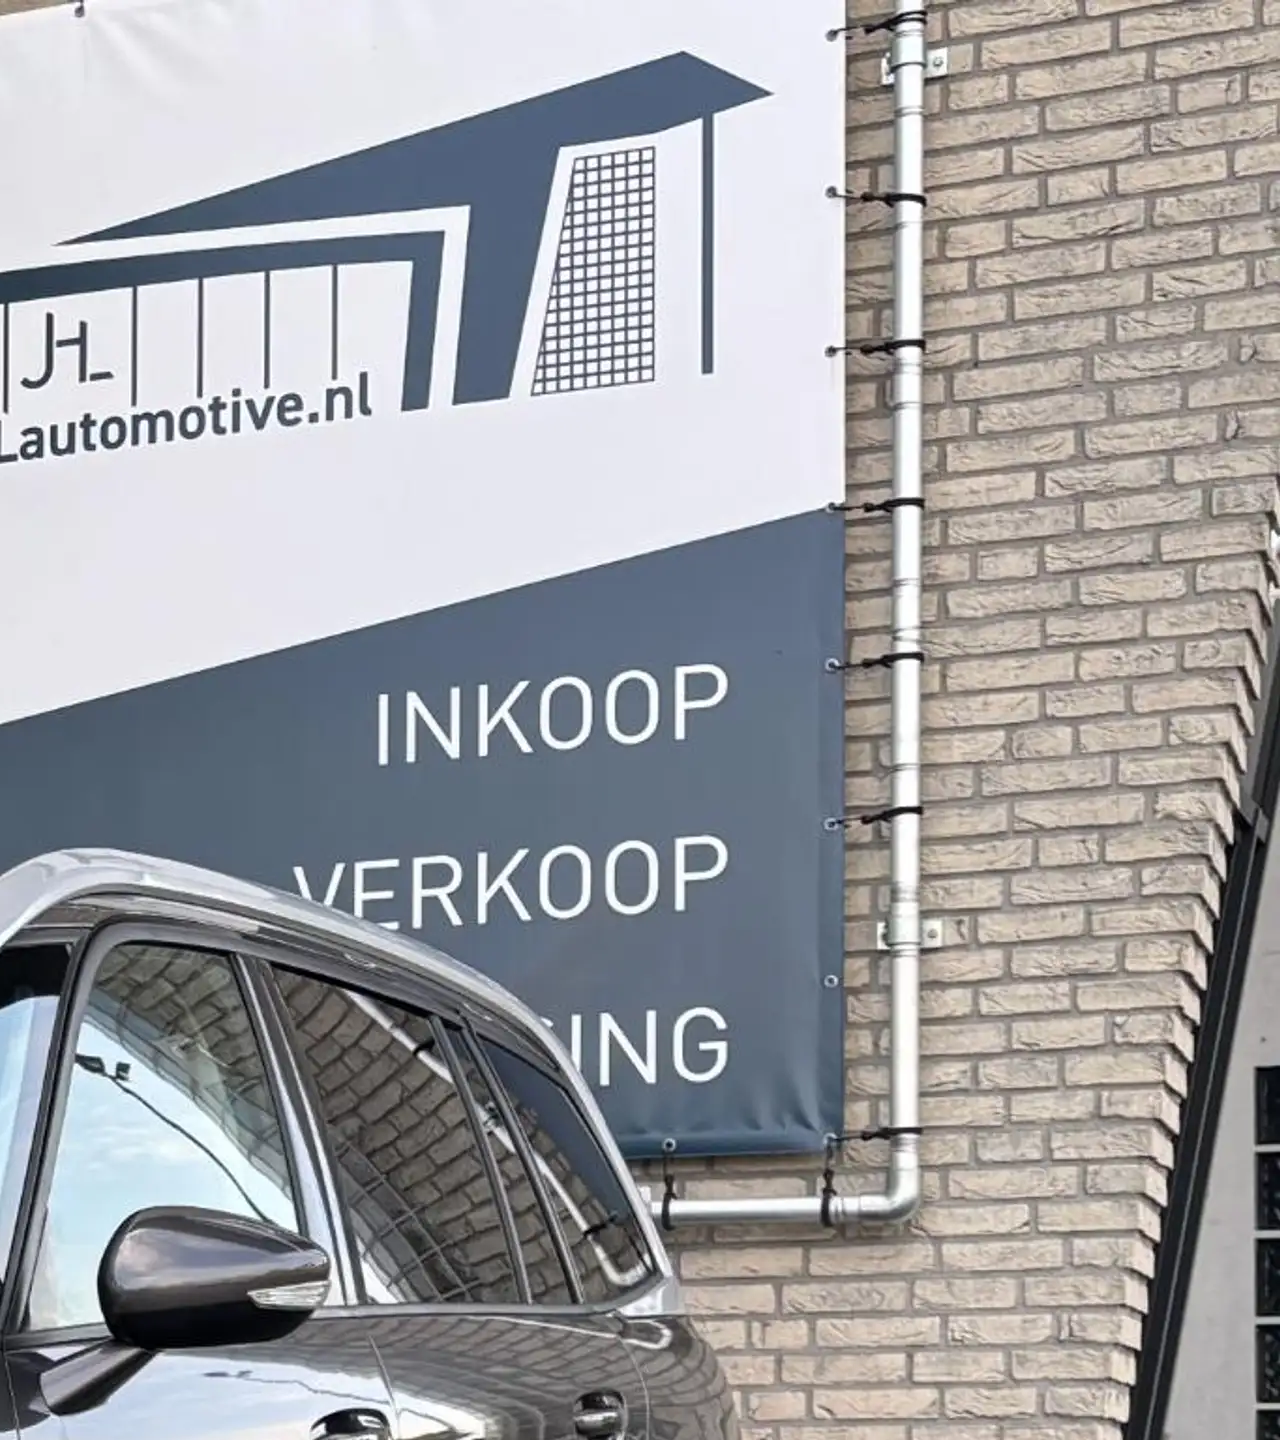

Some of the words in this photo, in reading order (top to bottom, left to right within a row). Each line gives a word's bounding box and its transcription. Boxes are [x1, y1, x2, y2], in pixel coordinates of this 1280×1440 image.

[20, 312, 114, 390] JHL
[378, 663, 728, 766] INKOOP
[292, 835, 728, 931] VERKOOP
[540, 1006, 728, 1087] ING
